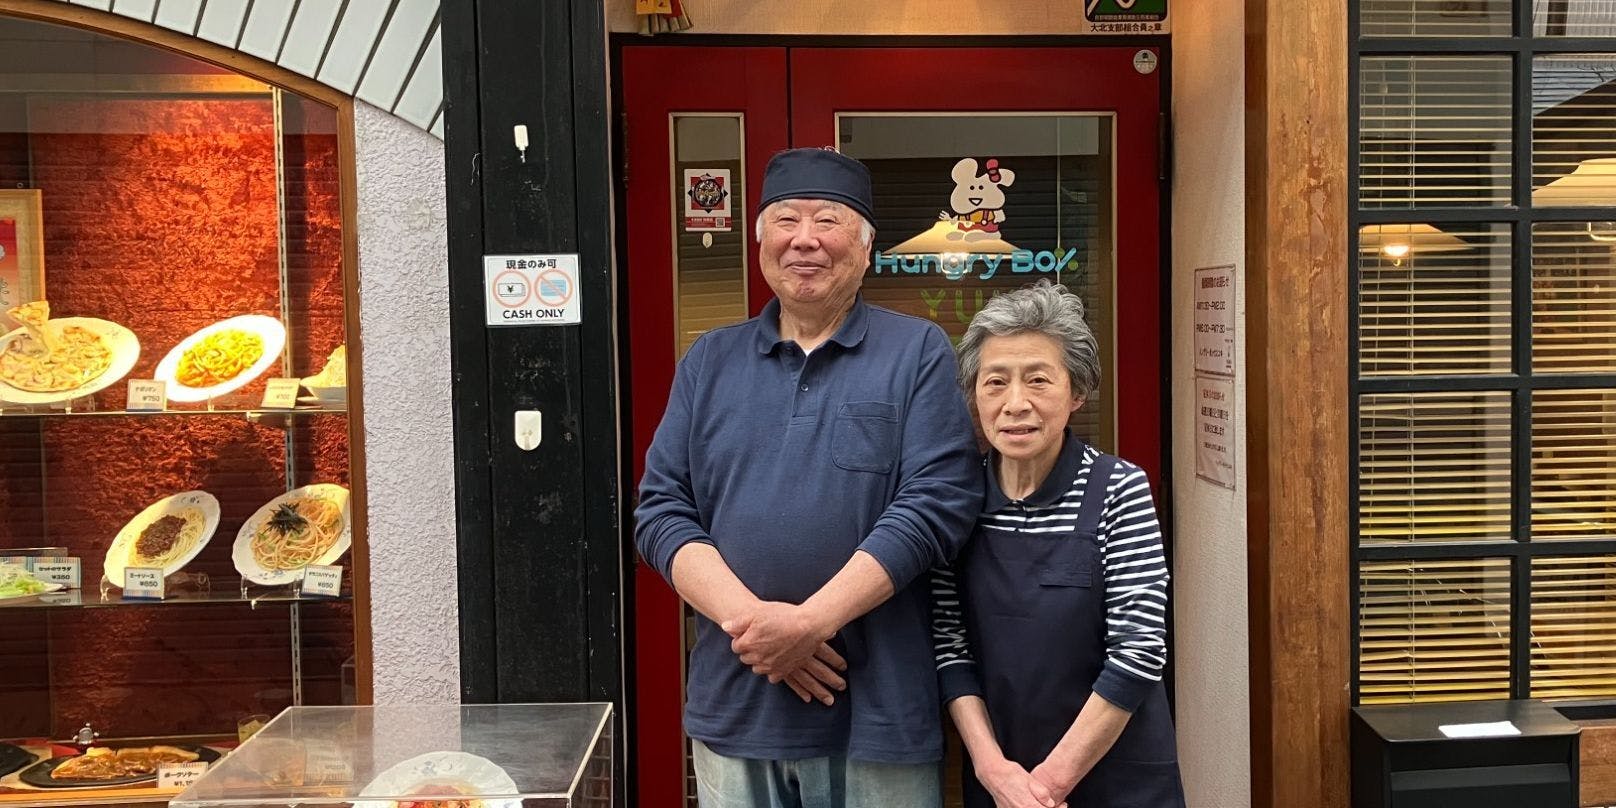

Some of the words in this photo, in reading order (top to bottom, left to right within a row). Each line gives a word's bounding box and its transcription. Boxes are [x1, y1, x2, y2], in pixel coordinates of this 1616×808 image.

[506, 259, 557, 269] 現金のみ可
[875, 249, 1002, 280] Hungry
[502, 310, 532, 319] CASH
[536, 309, 565, 318] ONLY
